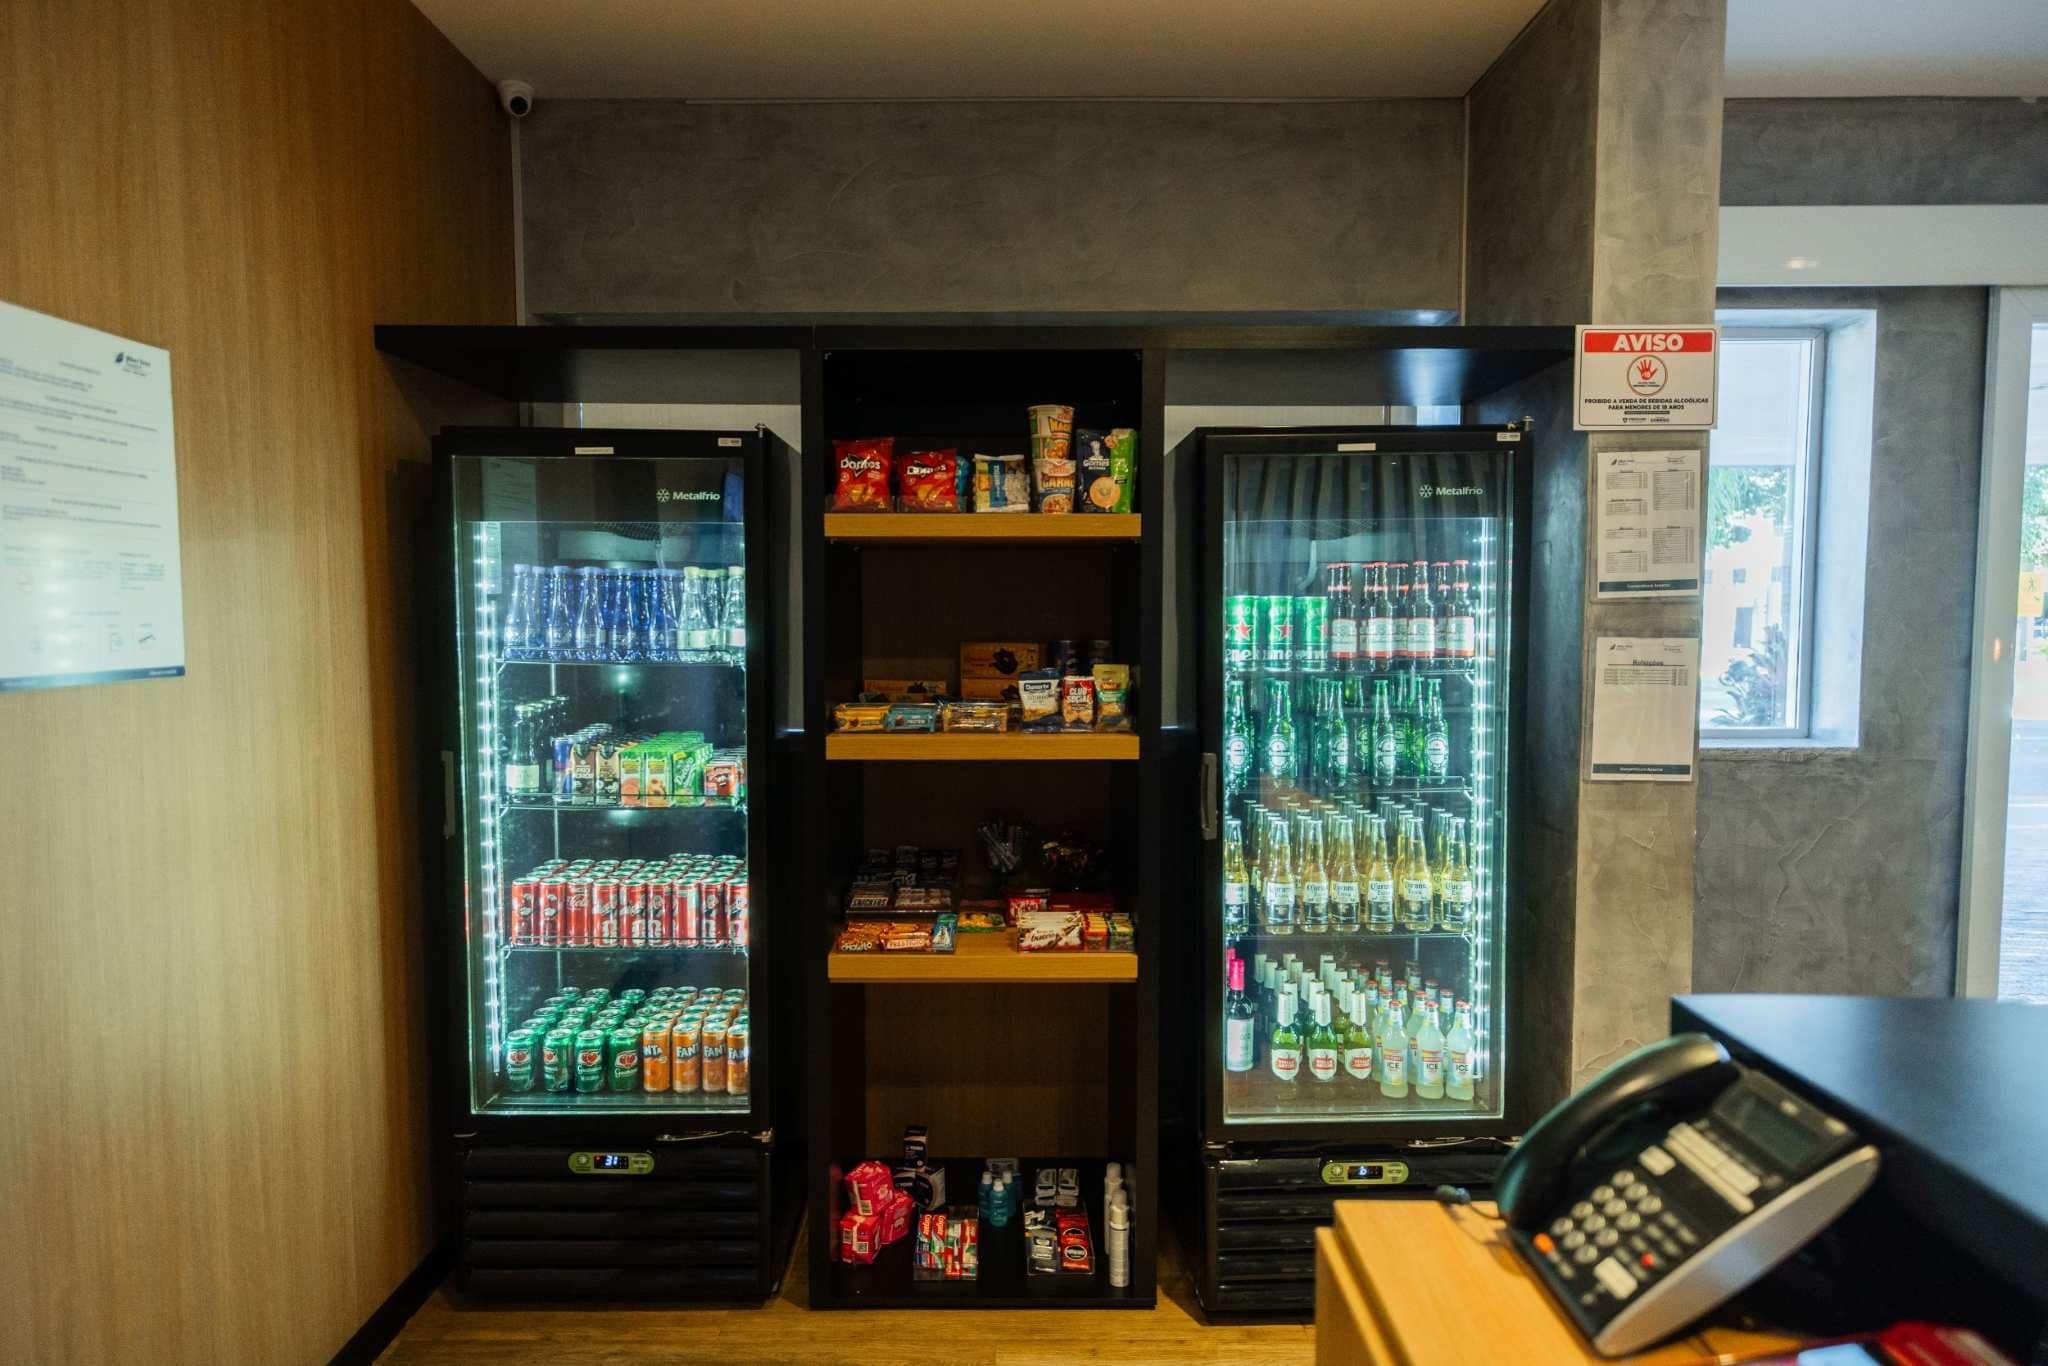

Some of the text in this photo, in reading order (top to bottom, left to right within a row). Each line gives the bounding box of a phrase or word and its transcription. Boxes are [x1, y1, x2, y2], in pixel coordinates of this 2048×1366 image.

[1613, 334, 1684, 351] AVISO
[841, 457, 880, 470] Doritos
[673, 491, 720, 500] Metalfrio
[1436, 487, 1483, 496] Metalfrio
